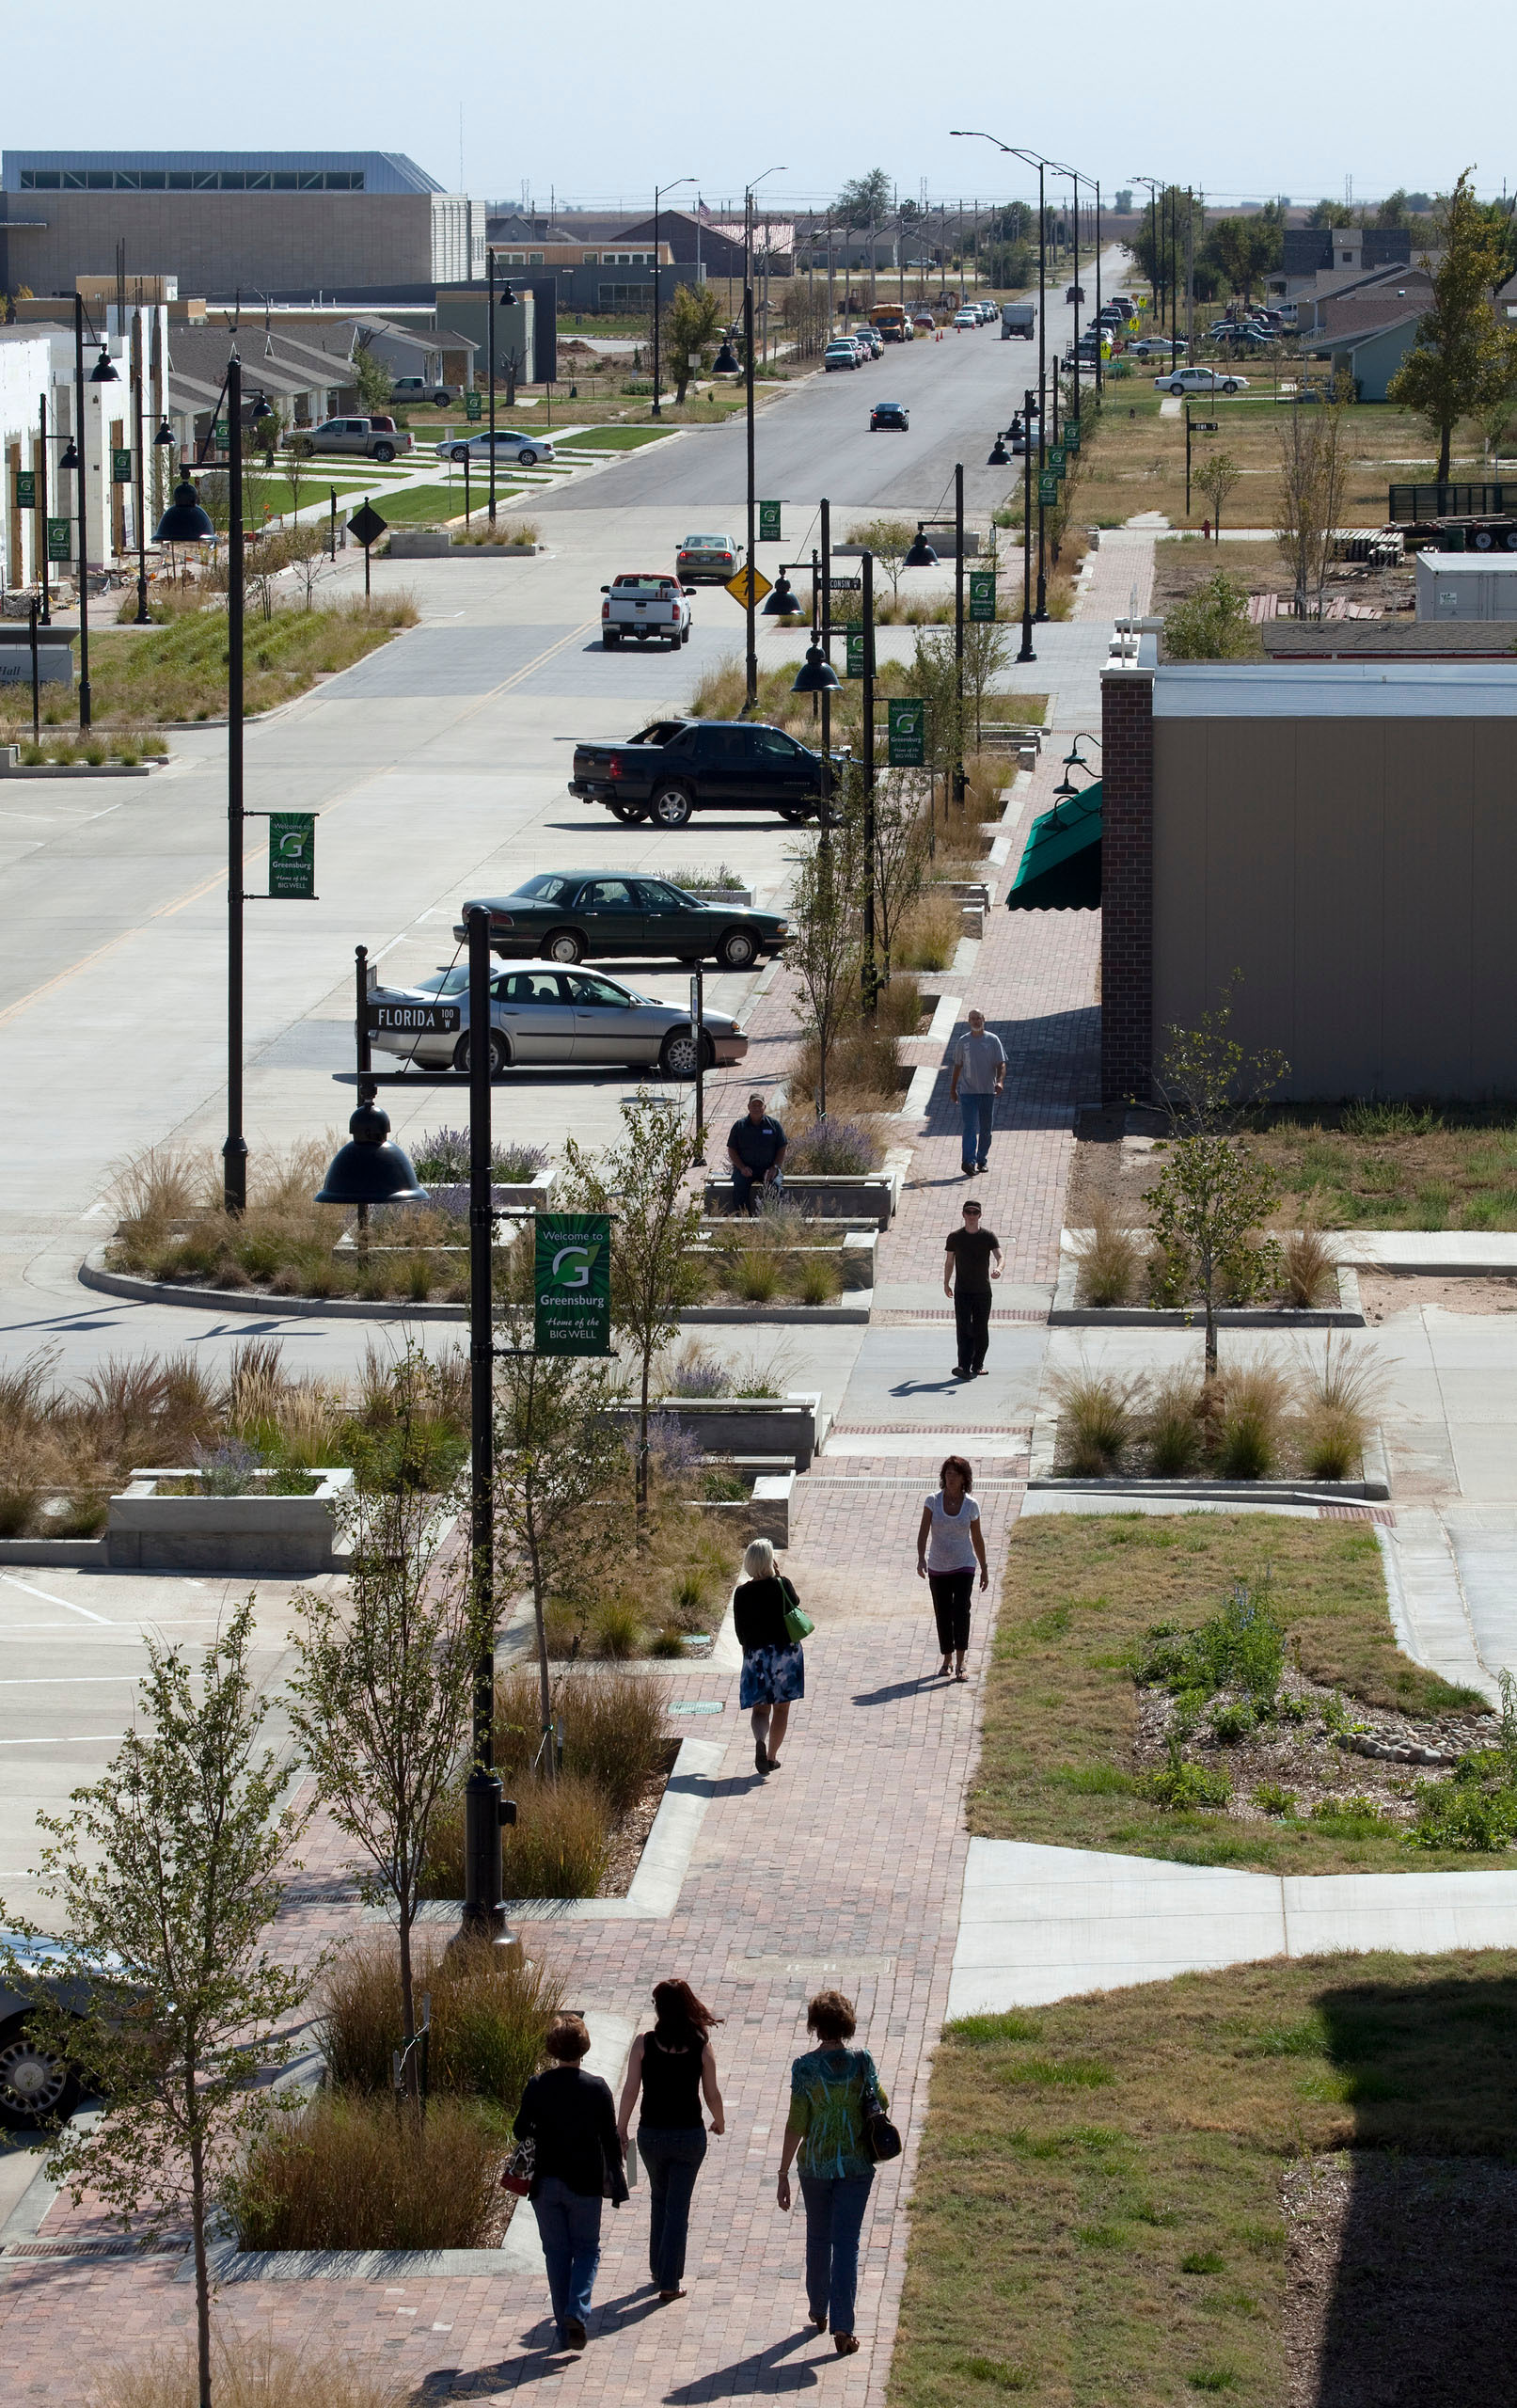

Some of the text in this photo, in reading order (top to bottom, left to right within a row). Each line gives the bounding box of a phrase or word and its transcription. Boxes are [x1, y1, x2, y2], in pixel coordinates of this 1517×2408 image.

[896, 713, 914, 734] G
[279, 832, 302, 858] G
[272, 861, 311, 871] Greensburg
[378, 1008, 454, 1027] FLORIDA 100
[444, 1020, 451, 1028] W
[543, 1231, 603, 1241] Welcome to
[552, 1245, 589, 1288] G
[540, 1294, 605, 1308] Greensburg
[545, 1317, 600, 1329] Home of the
[549, 1330, 597, 1339] BIG WELL
